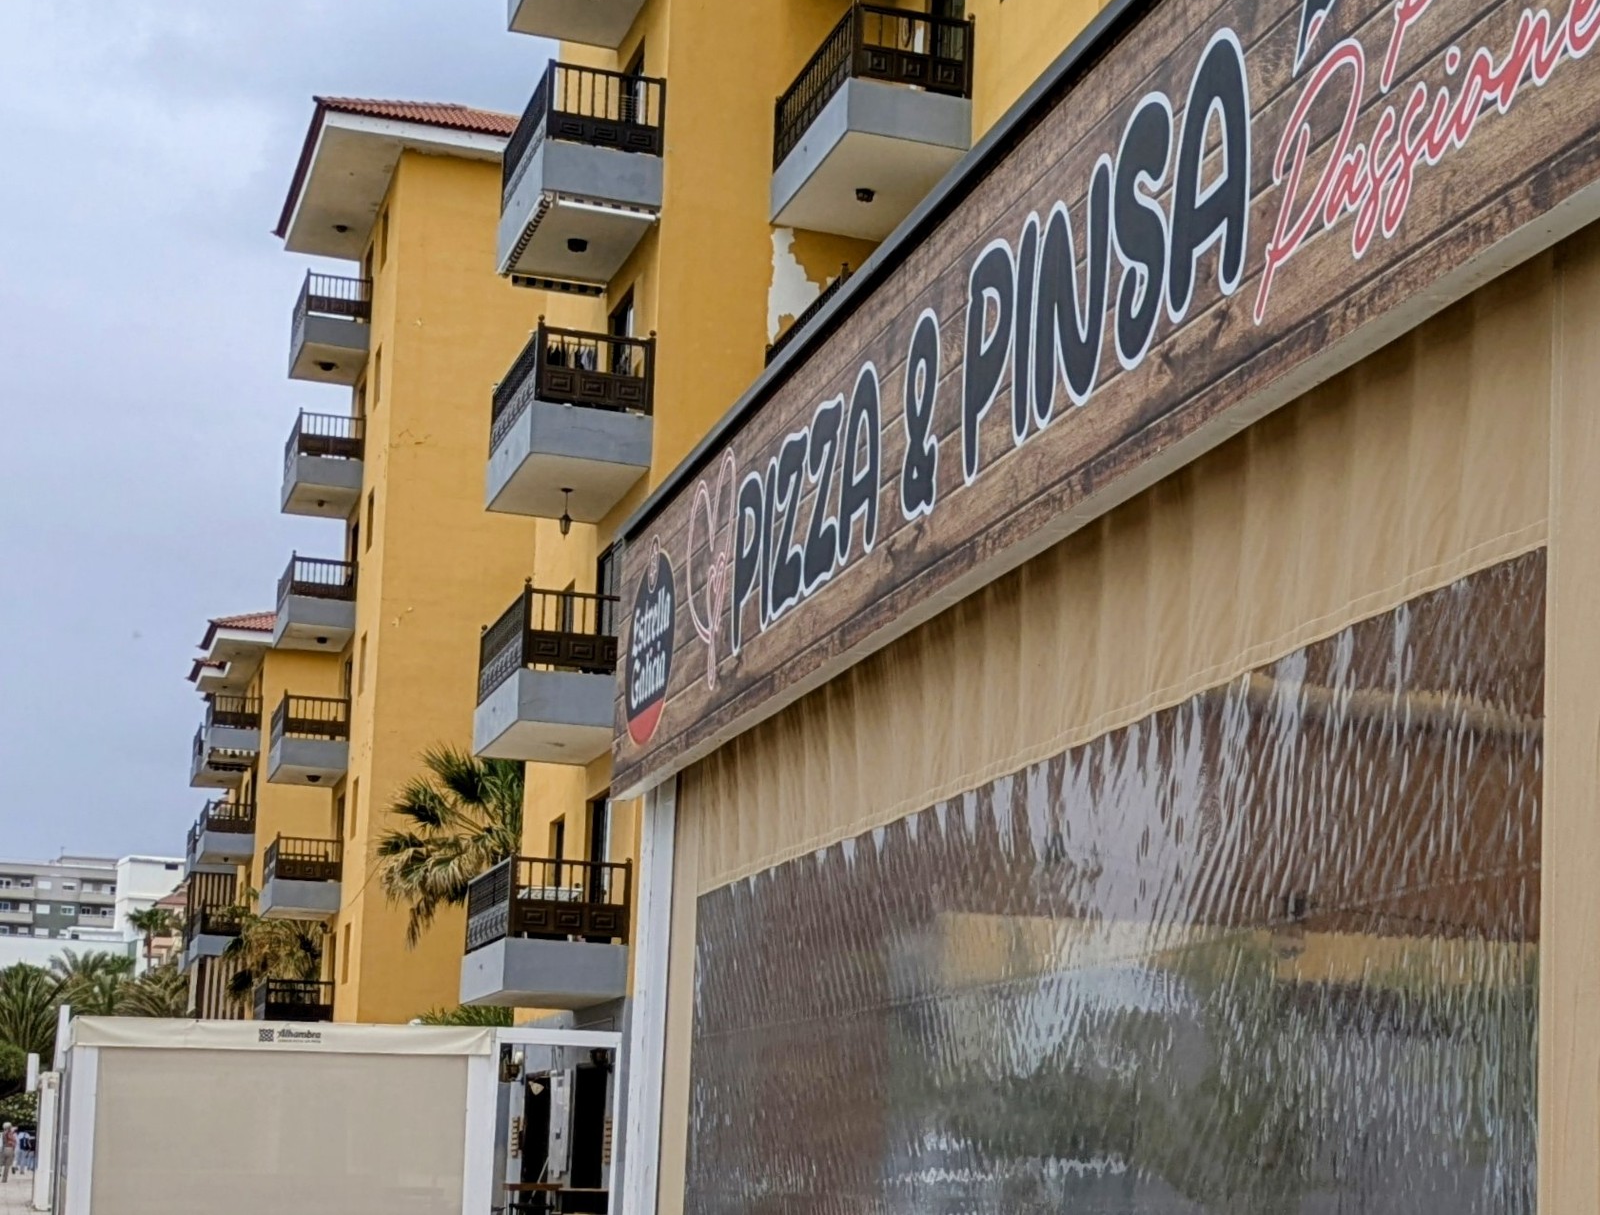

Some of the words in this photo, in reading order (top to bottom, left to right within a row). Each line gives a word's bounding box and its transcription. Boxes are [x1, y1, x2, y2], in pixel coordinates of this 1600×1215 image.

[731, 361, 881, 656] PIZZA
[900, 308, 940, 521] &
[962, 27, 1251, 486] PINSA
[631, 587, 671, 657] Estrella
[630, 640, 666, 710] Galicia
